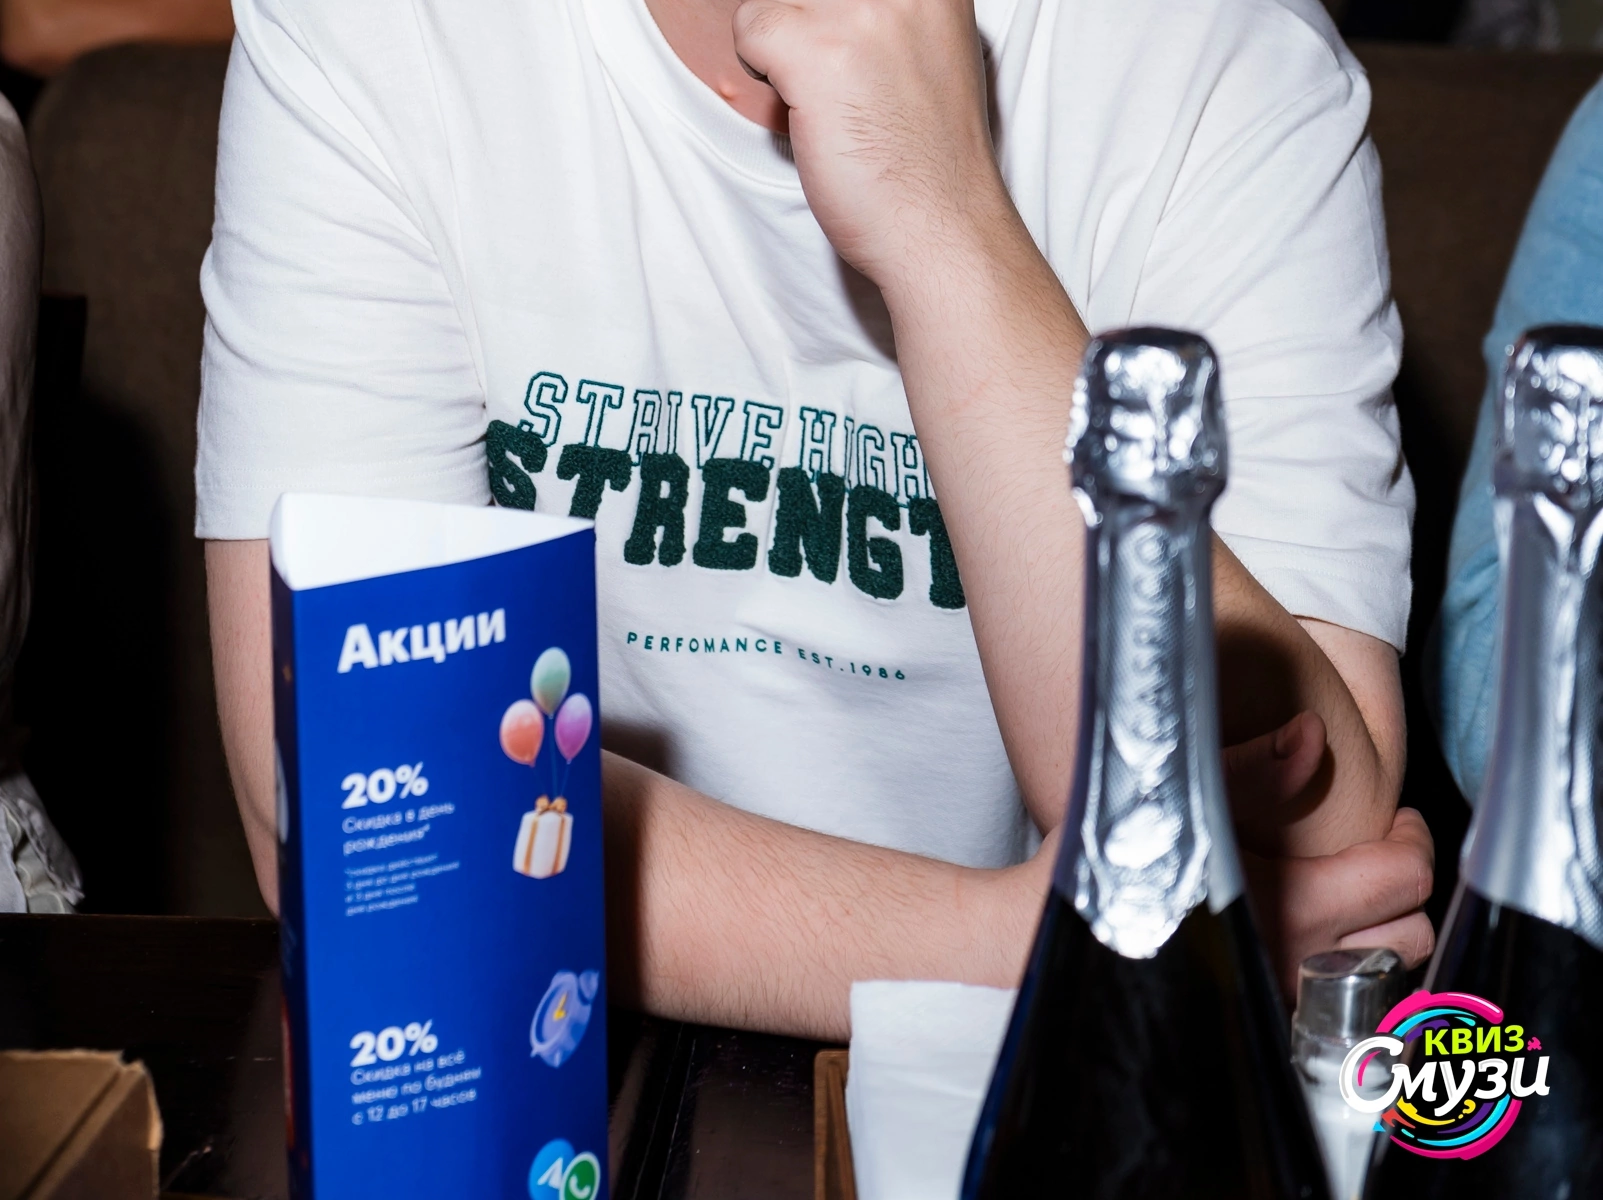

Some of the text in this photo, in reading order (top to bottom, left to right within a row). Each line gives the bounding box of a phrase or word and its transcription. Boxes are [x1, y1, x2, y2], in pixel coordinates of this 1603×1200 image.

[518, 371, 784, 471] STRIVE
[337, 607, 506, 674] Акции
[627, 631, 906, 681] PERFOMANCE EST.1986
[341, 761, 430, 810] 20%
[342, 803, 456, 834] Скидка в день
[349, 1019, 438, 1068] 20%
[350, 1063, 412, 1086] Скидка
[414, 1058, 435, 1072] на
[351, 1066, 482, 1105] меню по будням
[351, 1088, 477, 1126] с 12 до 17 часов
